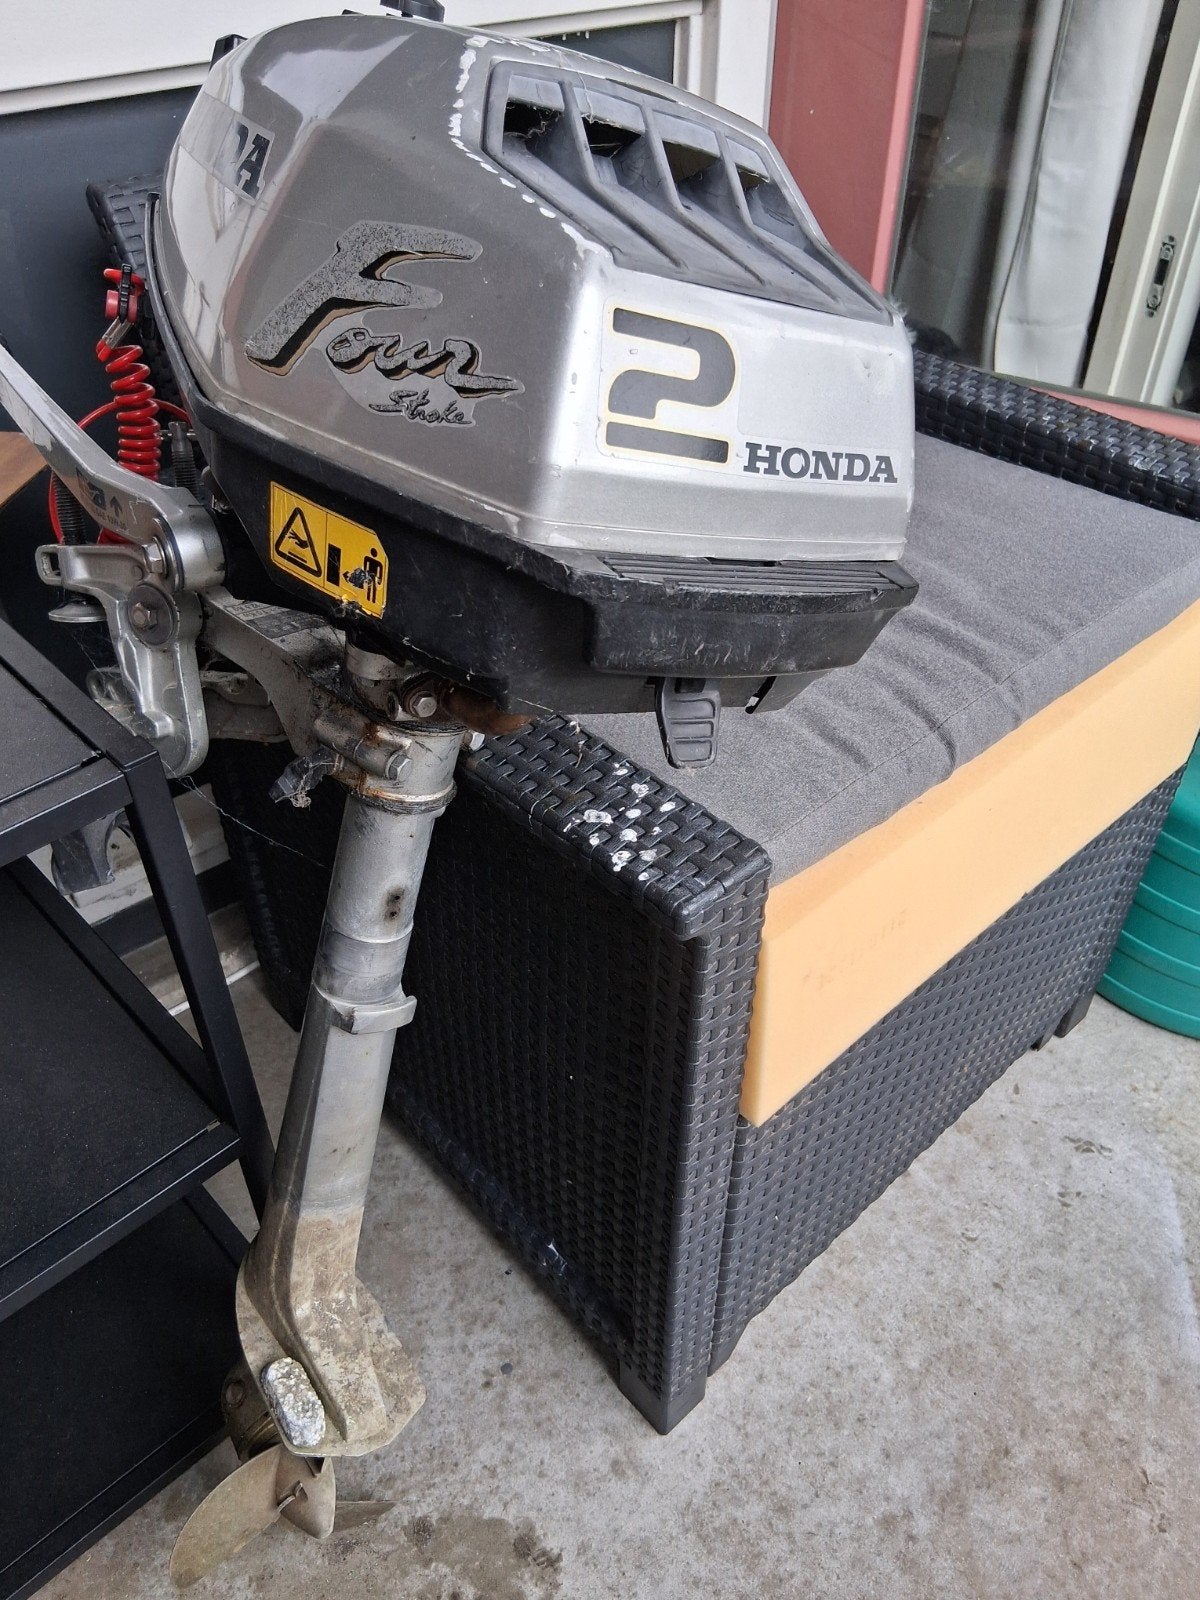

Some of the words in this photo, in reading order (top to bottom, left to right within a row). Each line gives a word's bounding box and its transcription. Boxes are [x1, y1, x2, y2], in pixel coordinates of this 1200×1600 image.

[246, 220, 519, 399] Four
[368, 388, 473, 425] Stroke
[605, 306, 737, 464] 2
[742, 441, 898, 484] HONDA
